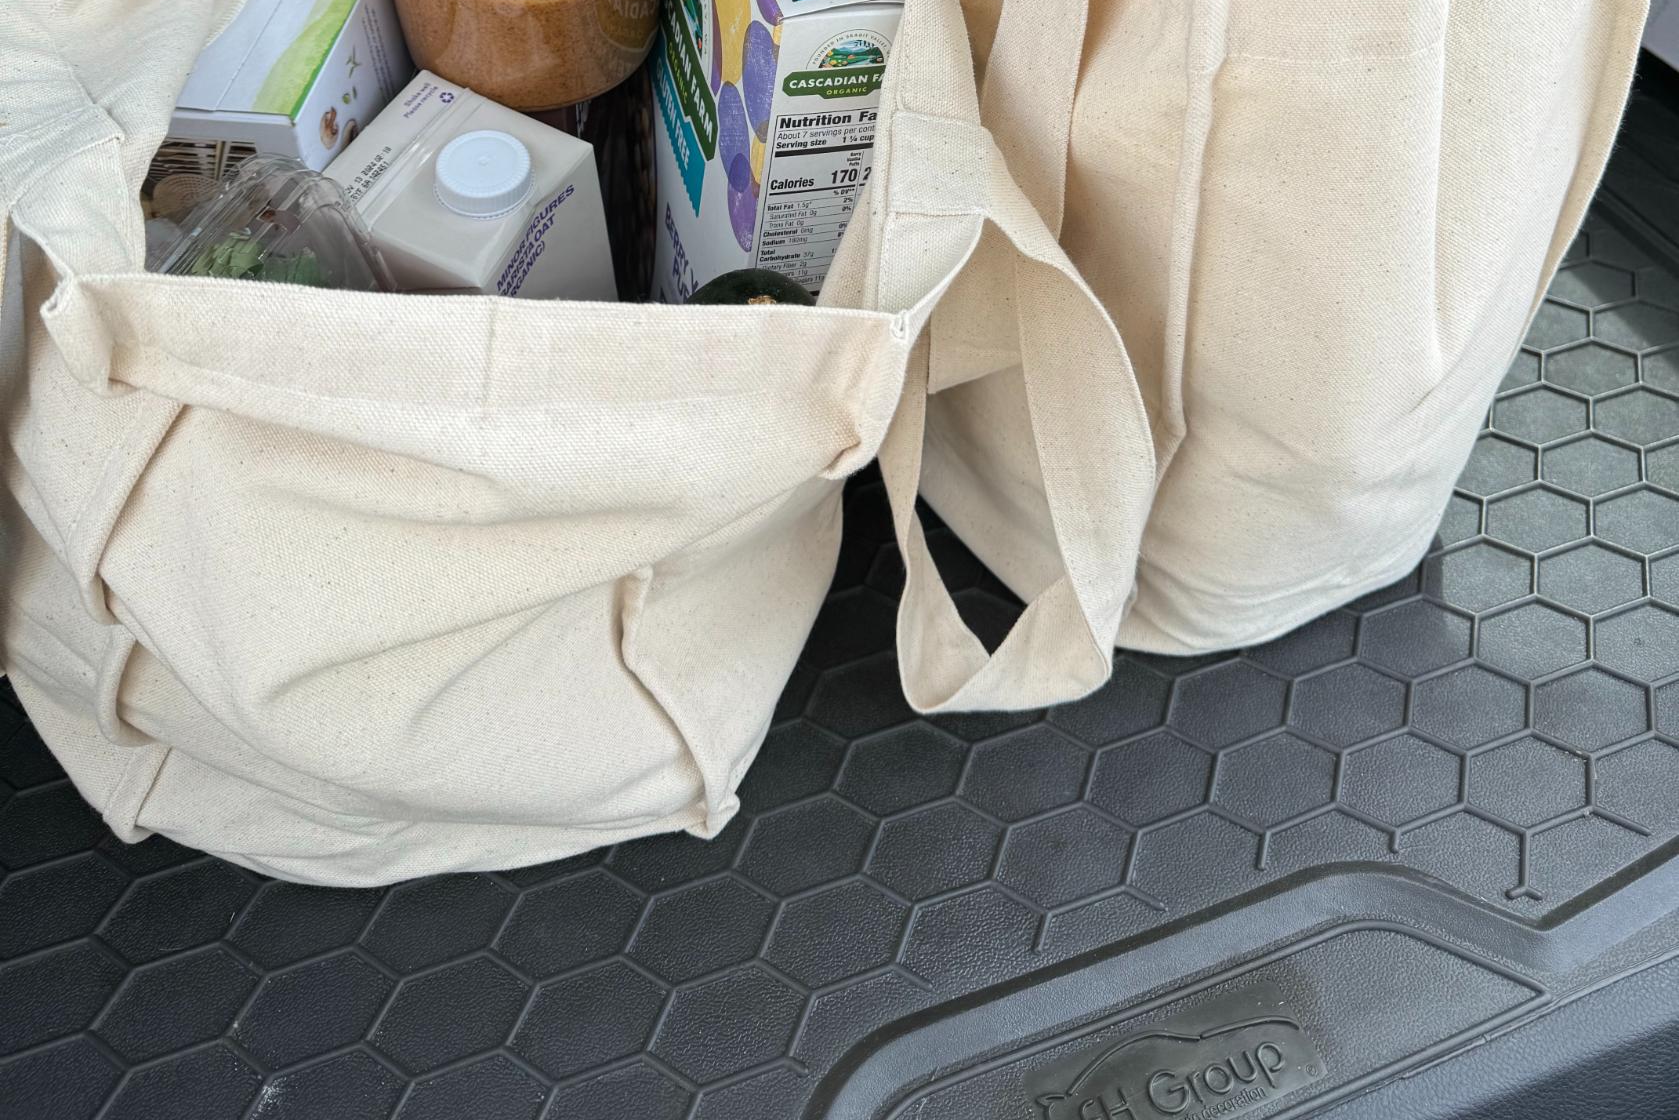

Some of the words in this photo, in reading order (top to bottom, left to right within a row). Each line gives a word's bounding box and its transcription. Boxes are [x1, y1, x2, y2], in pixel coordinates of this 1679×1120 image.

[789, 75, 868, 89] CASCADIAN
[826, 87, 868, 95] ORGANIC
[403, 90, 421, 107] Shake
[403, 102, 422, 119] Please
[656, 57, 677, 129] GLUTEN
[674, 119, 690, 171] FREE
[691, 74, 713, 143] FARM
[779, 114, 852, 129] Nutrition
[777, 132, 800, 140] About
[809, 128, 842, 137] servings
[843, 127, 857, 136] per
[776, 141, 808, 149] Serving
[770, 177, 815, 190] Calories
[831, 168, 858, 184] 170
[534, 213, 556, 241] OAT
[763, 229, 798, 237] Cholesterol
[496, 240, 526, 291] MINOR
[526, 184, 575, 241] FIGURES
[665, 201, 689, 276] BERRY
[760, 253, 801, 262] Carbohydrate
[510, 240, 545, 297] RGANIC)
[1148, 1040, 1286, 1115] Group
[1200, 1084, 1267, 1120] decoration
